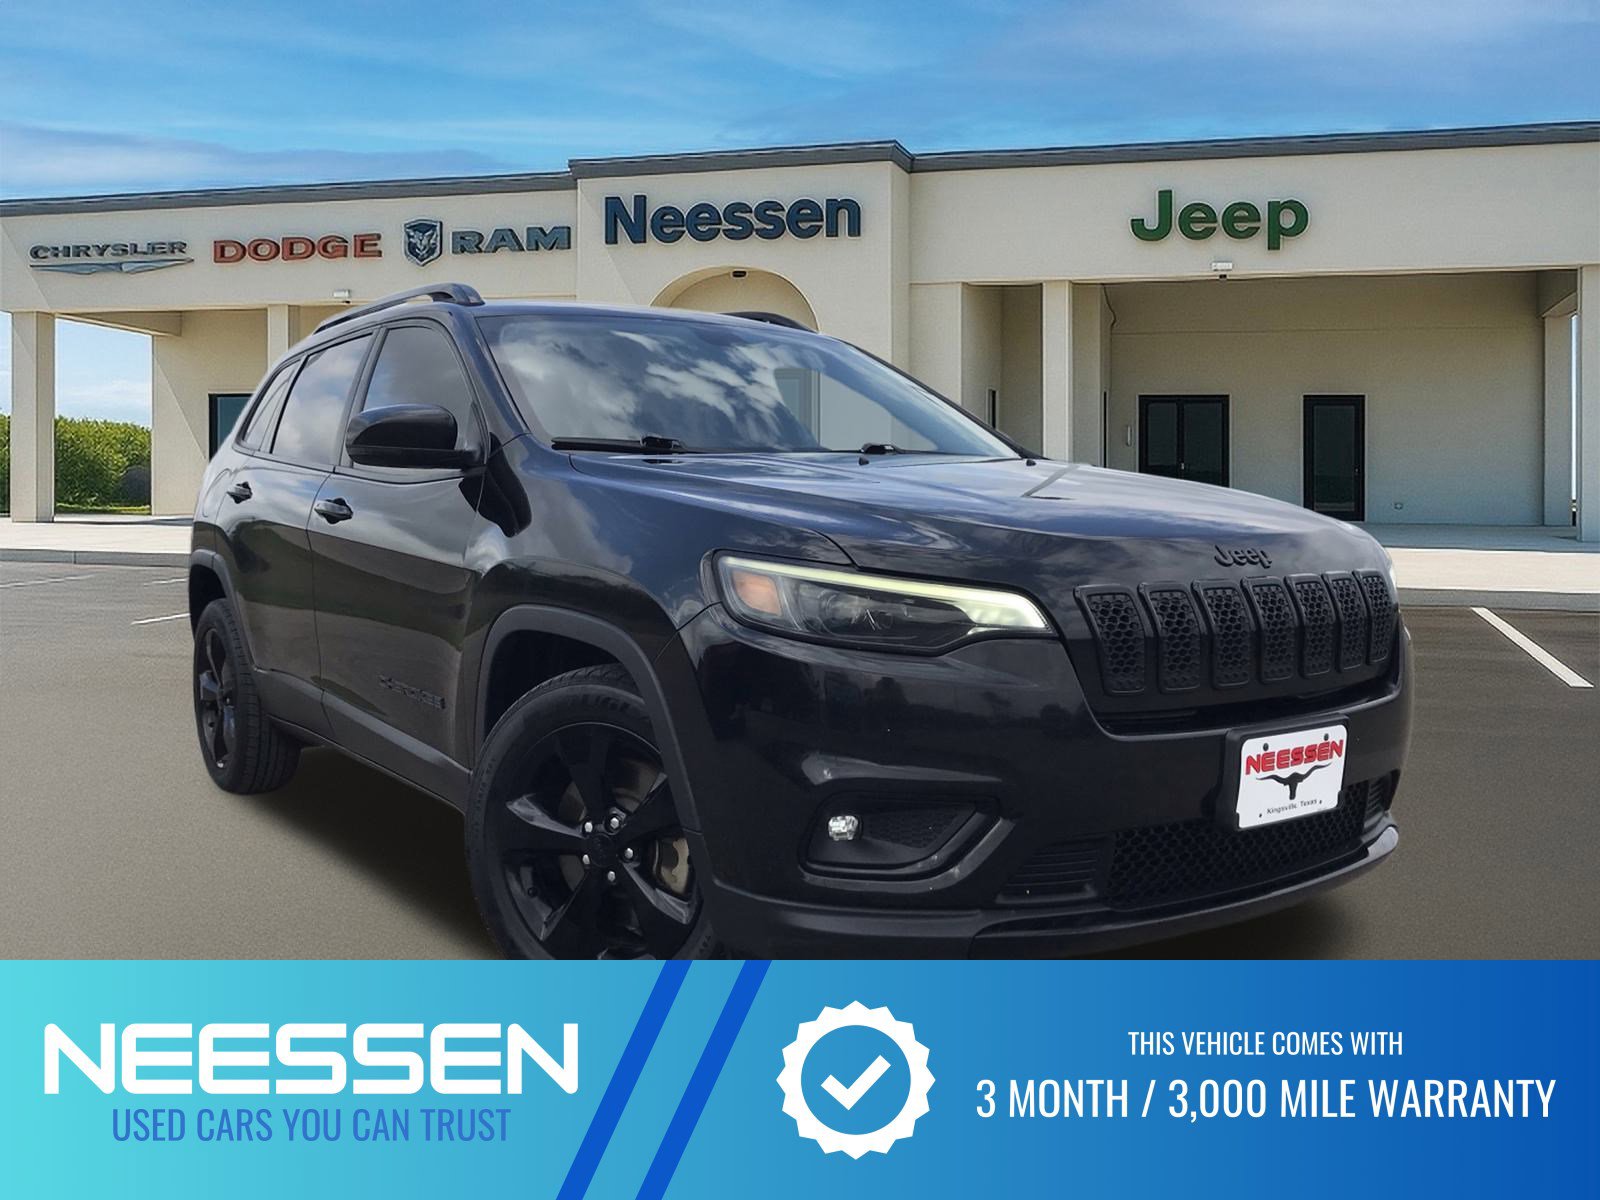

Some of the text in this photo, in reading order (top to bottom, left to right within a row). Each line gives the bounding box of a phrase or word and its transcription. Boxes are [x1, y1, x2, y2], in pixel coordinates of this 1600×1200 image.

[604, 194, 862, 245] Neessen
[1130, 189, 1309, 250] Jeep
[29, 241, 187, 259] CHRYSLER
[213, 233, 382, 264] DODGE
[451, 226, 571, 254] RAM
[1214, 544, 1272, 569] Jeep
[1246, 740, 1344, 775] NEESSEN
[1300, 799, 1318, 807] Texas
